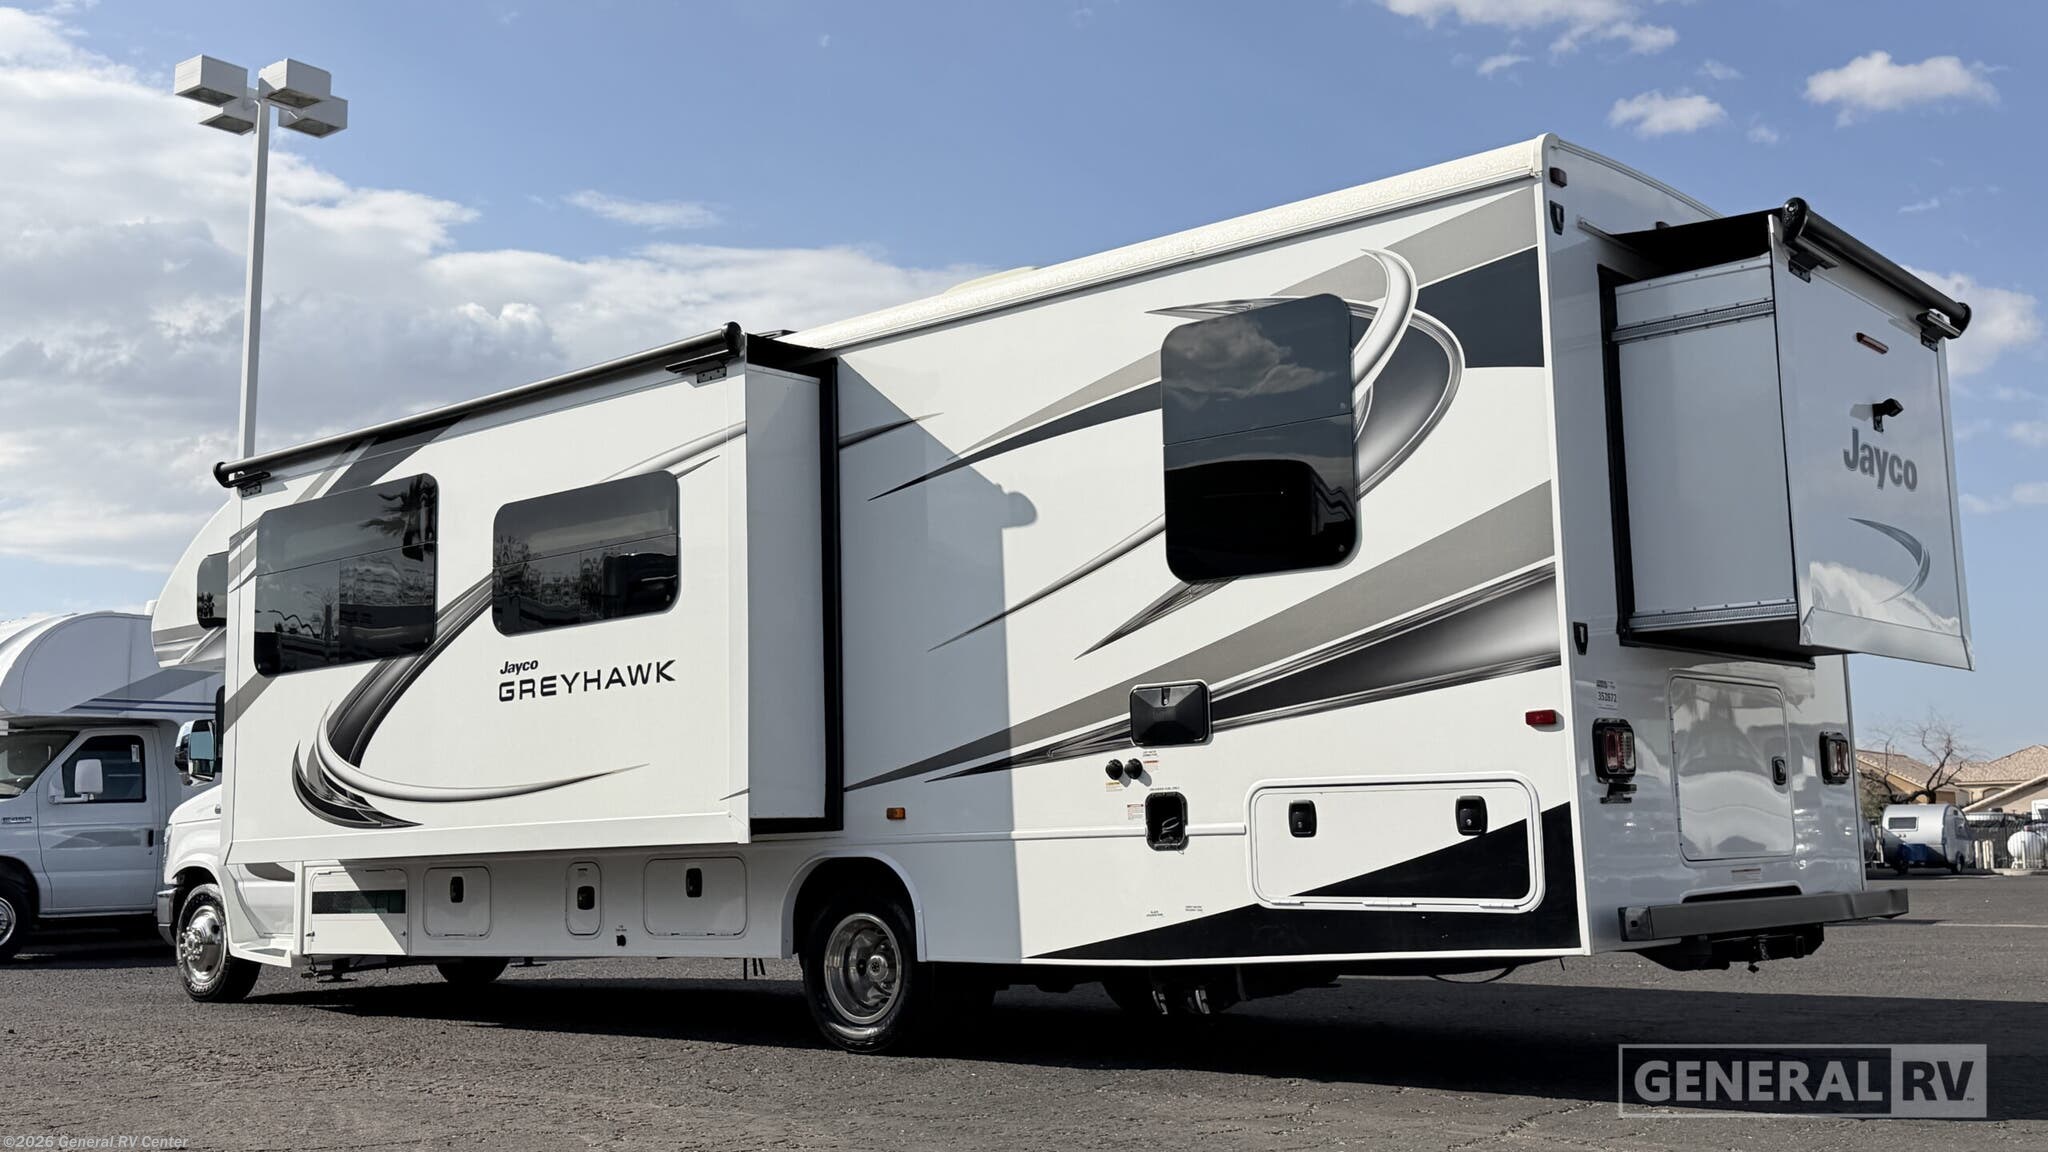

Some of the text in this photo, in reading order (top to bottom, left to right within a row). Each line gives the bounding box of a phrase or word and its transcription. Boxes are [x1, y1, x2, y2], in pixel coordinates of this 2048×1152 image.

[1843, 426, 1918, 492] Jayco
[499, 659, 676, 702] GREYHAWK
[500, 660, 538, 675] Jayco
